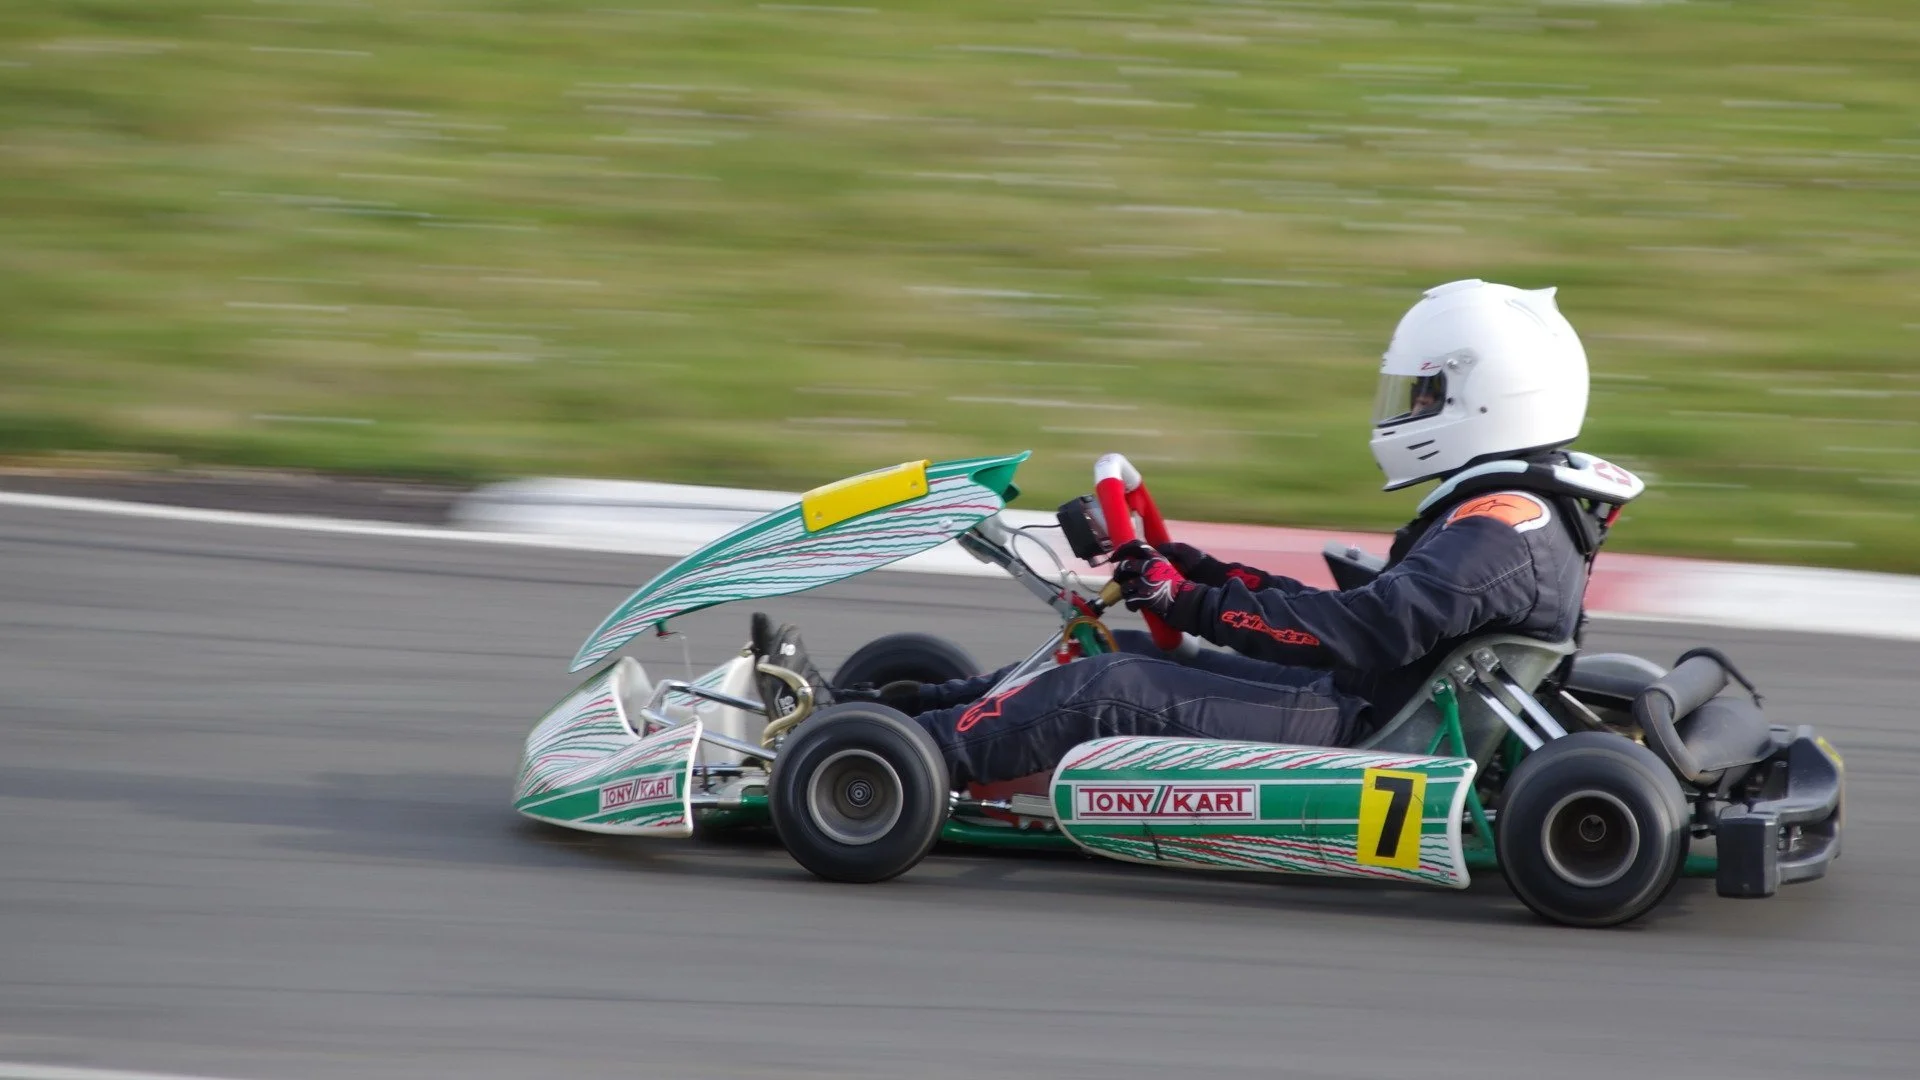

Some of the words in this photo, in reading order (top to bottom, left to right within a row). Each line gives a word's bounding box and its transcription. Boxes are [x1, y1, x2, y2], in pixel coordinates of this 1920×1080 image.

[1221, 611, 1320, 646] alpistars
[602, 782, 633, 806] TONY
[640, 776, 673, 797] KART
[1080, 788, 1155, 812] TONY
[1173, 788, 1252, 812] KART
[1374, 775, 1415, 859] 7
